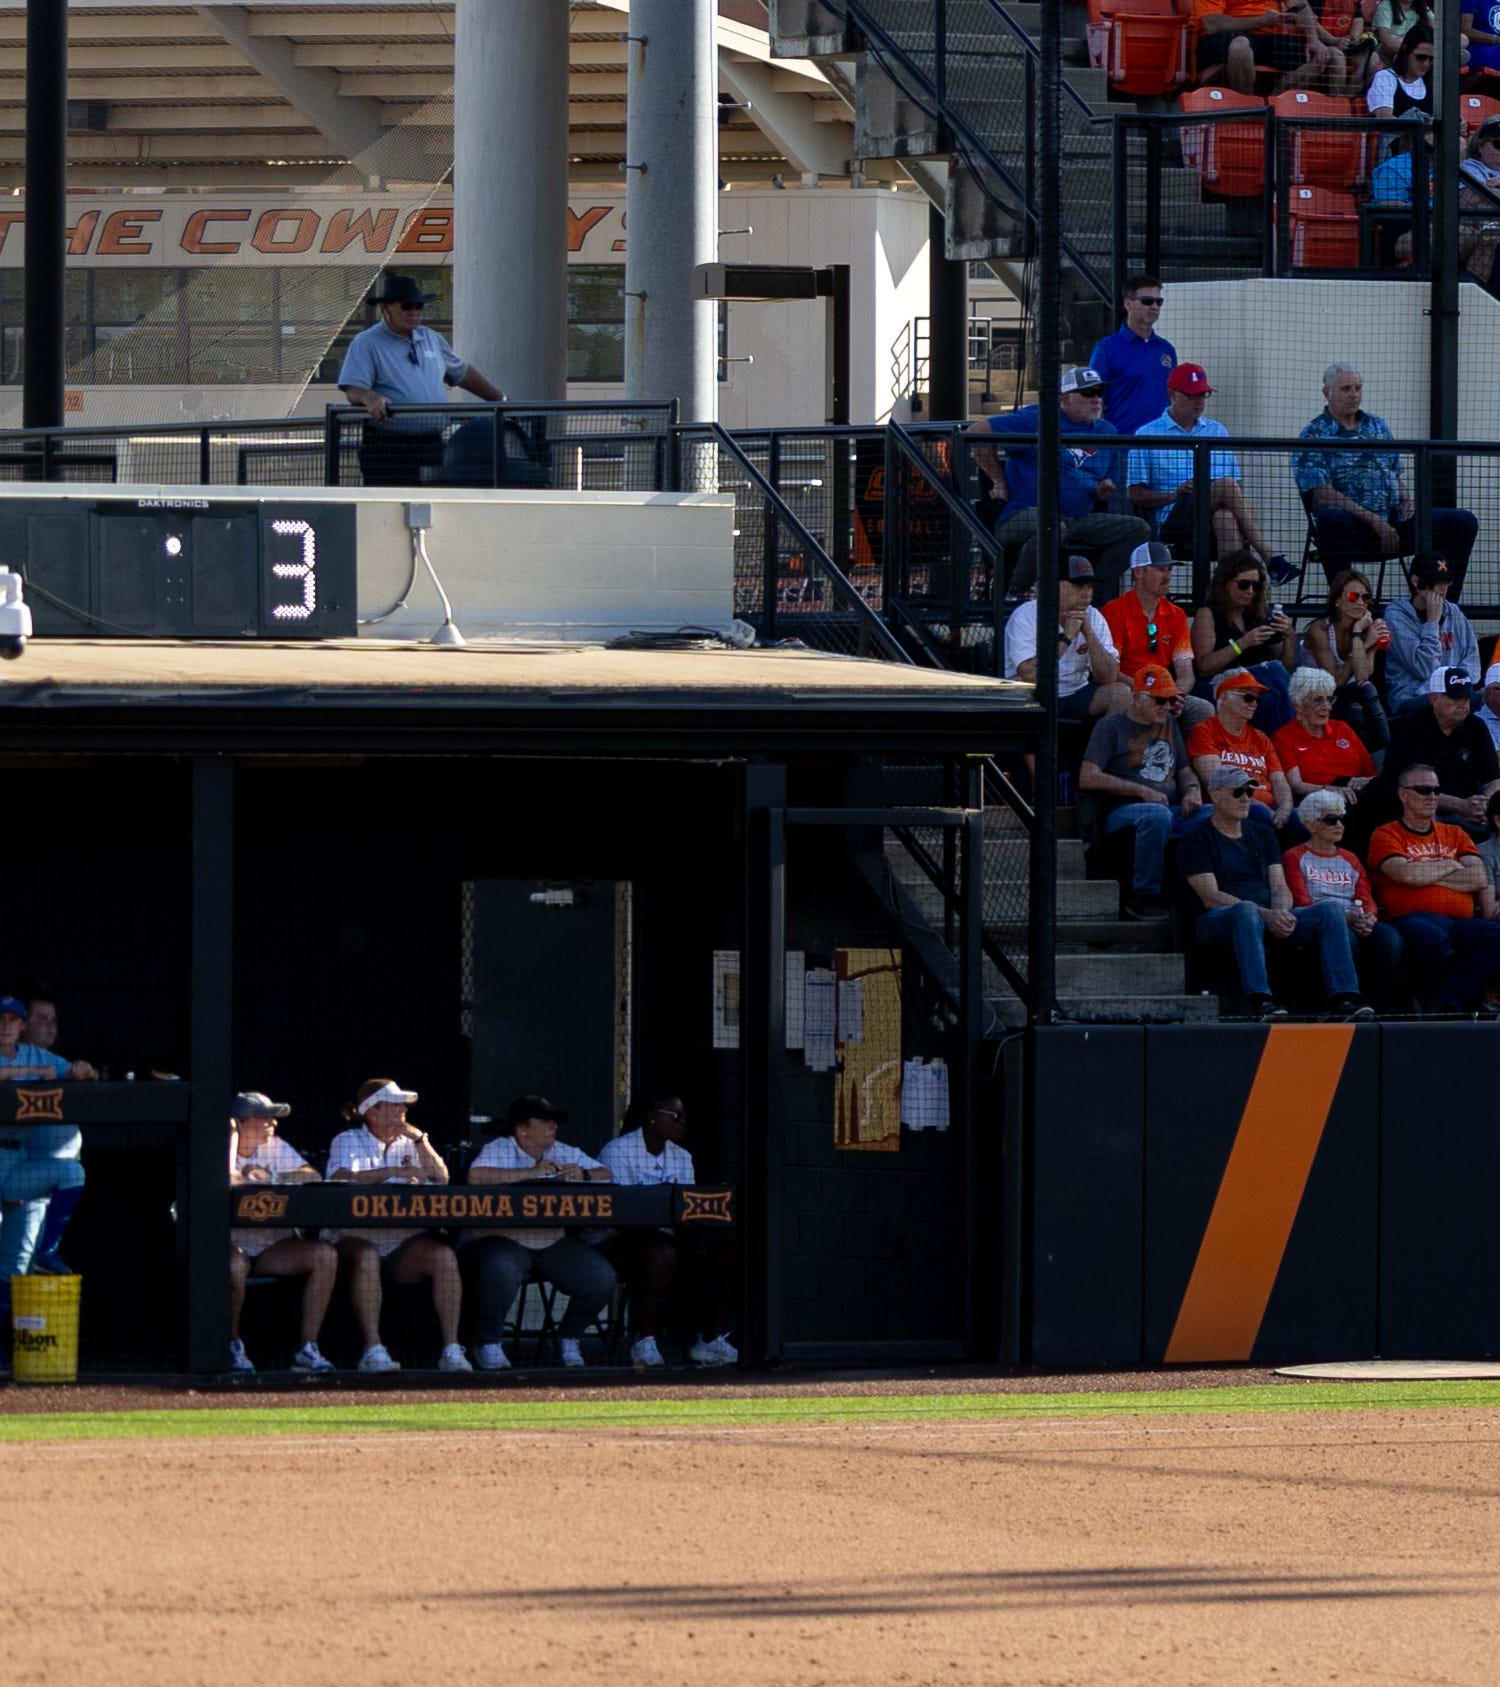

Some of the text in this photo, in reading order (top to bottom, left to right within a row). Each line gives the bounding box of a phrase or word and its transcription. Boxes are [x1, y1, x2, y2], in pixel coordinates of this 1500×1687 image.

[181, 209, 627, 254] COWBY
[138, 499, 210, 510] DAKTRONICS
[272, 518, 316, 622] 3
[238, 1191, 289, 1222] OSU
[351, 1193, 613, 1218] OKLAHOMA STATE
[12, 1329, 58, 1349] ilson
